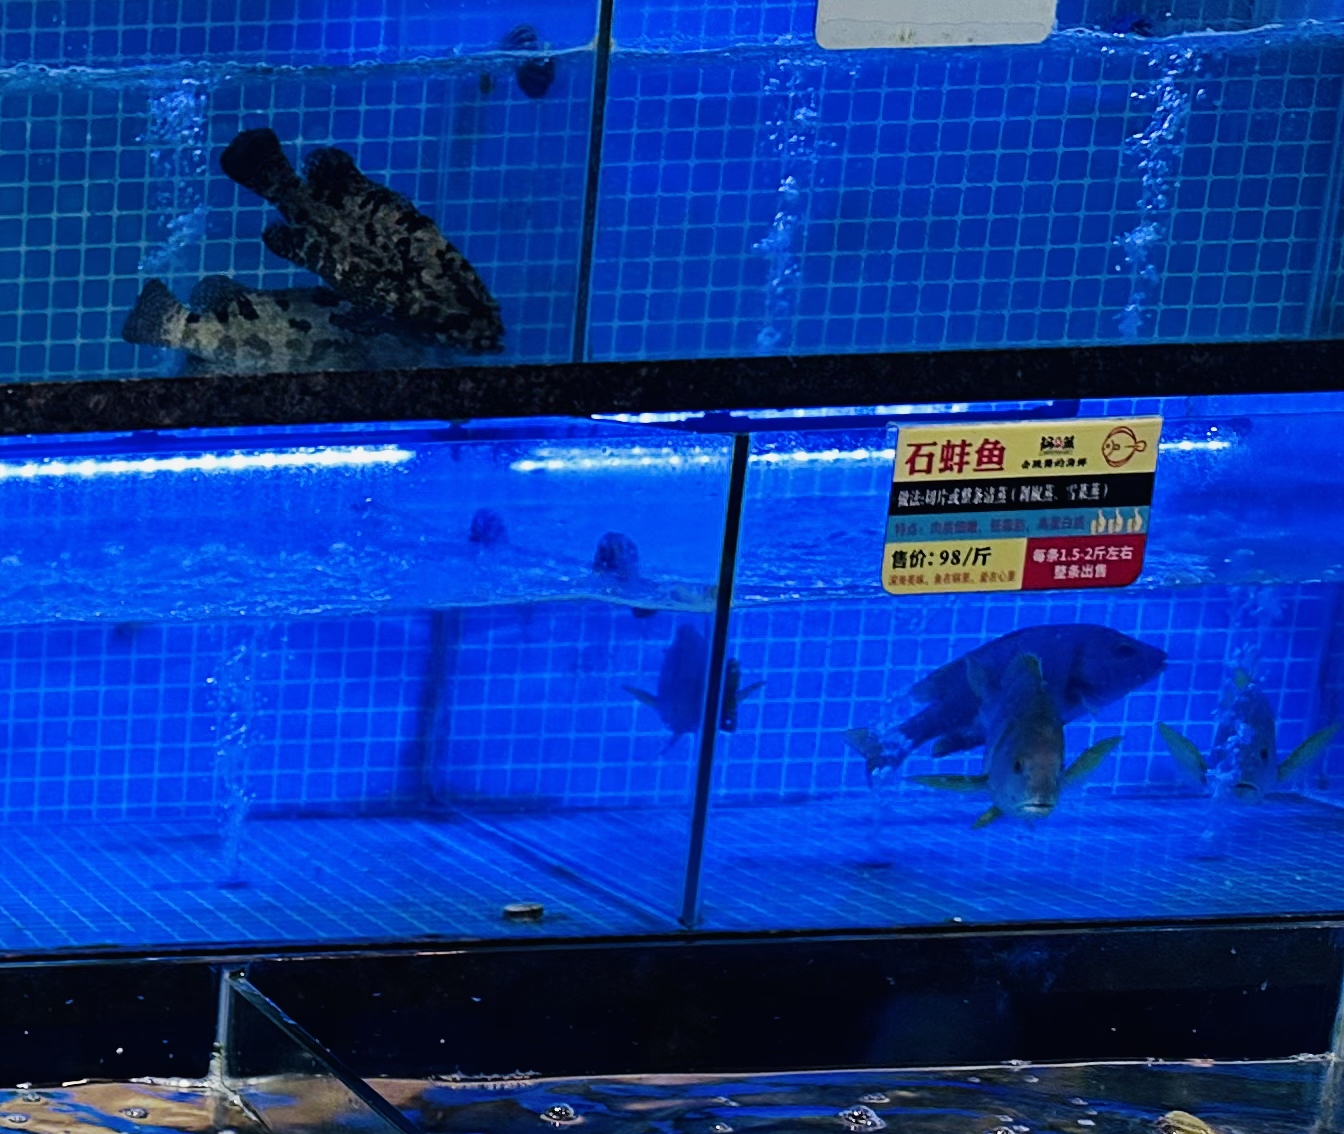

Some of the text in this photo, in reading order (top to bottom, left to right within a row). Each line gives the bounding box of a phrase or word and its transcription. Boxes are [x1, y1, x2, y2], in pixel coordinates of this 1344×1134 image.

[904, 438, 1006, 476] 石蚌鱼
[892, 547, 991, 569] 售价:98/斤
[1032, 545, 1133, 564] 每条1.5-2斤左右
[1054, 563, 1107, 580] 整条出售
